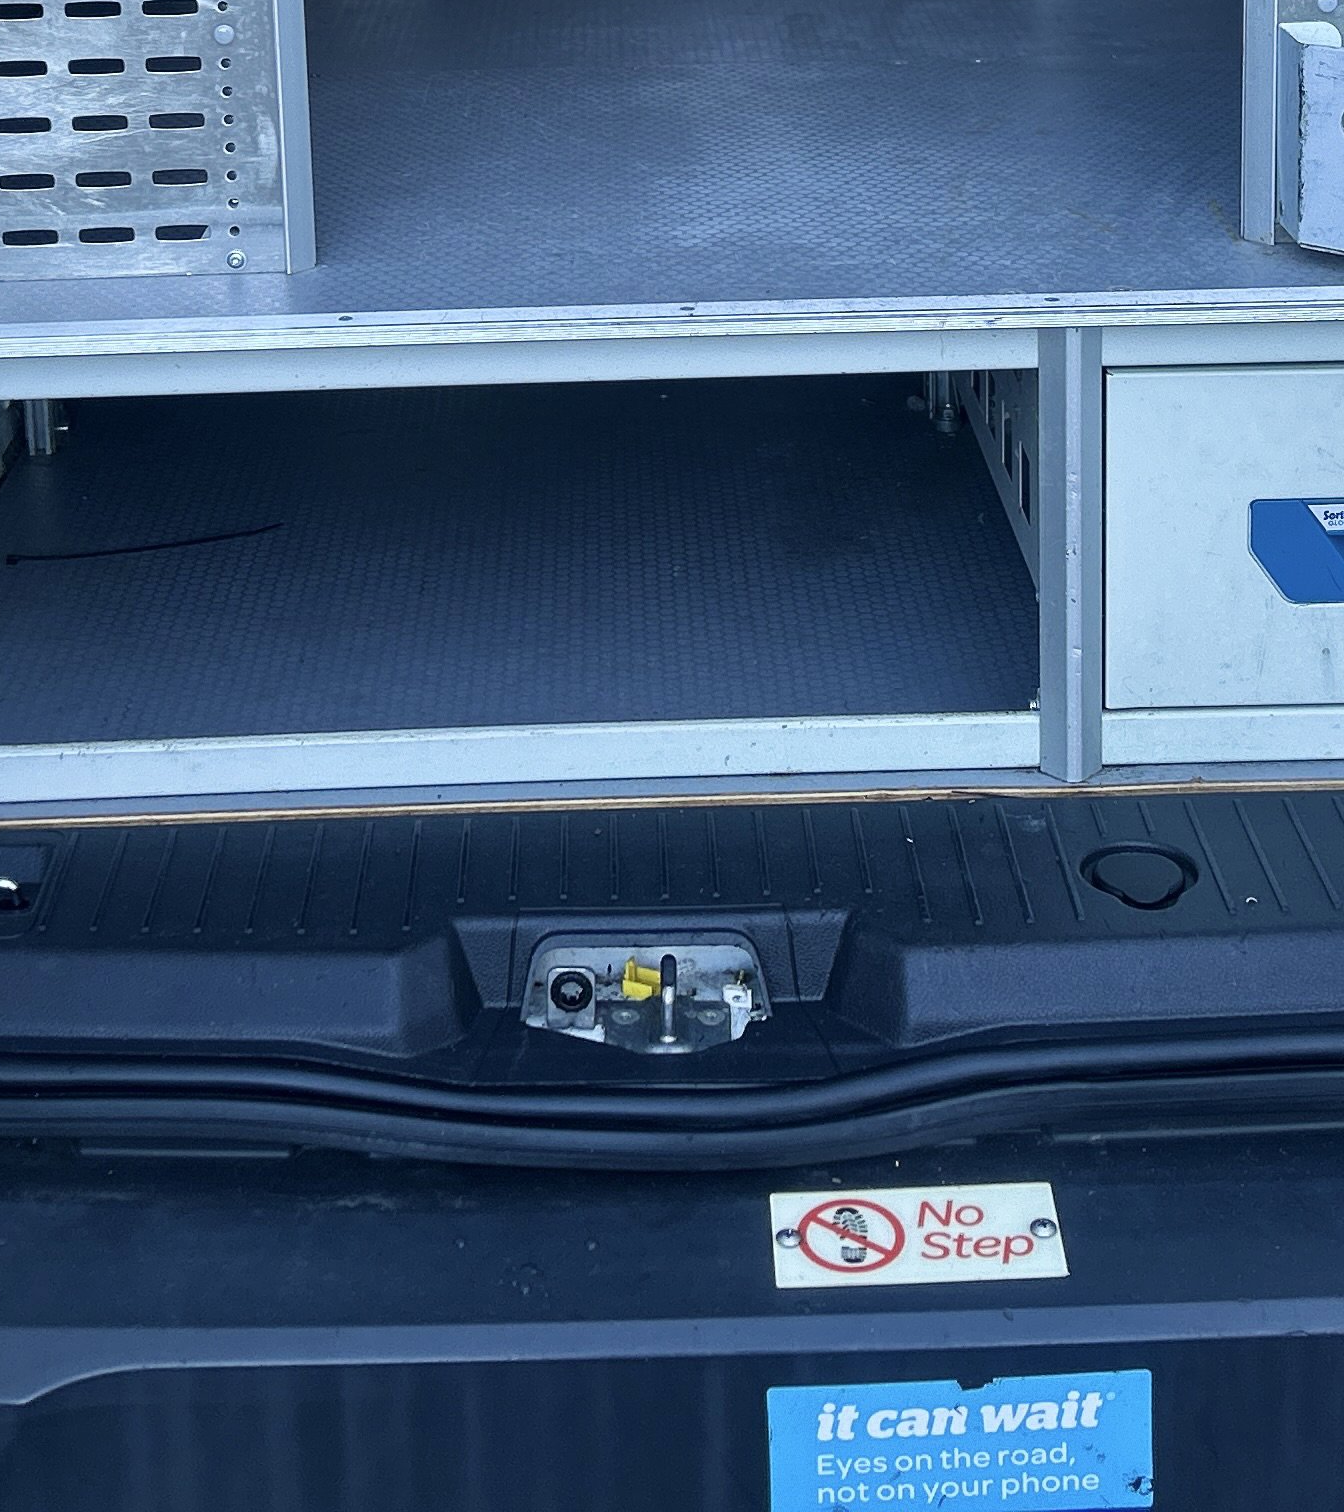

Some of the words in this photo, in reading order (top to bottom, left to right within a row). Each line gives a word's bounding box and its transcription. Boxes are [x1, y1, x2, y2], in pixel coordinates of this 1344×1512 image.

[917, 1199, 984, 1228] No
[921, 1232, 1034, 1265] Step
[817, 1402, 860, 1441] it
[866, 1405, 969, 1439] can
[980, 1390, 1104, 1432] wait
[817, 1453, 888, 1480] Eyes
[894, 1453, 933, 1473] on
[940, 1446, 991, 1470] the
[997, 1441, 1076, 1467] road,
[817, 1482, 870, 1504] not
[876, 1483, 915, 1501] on
[922, 1478, 994, 1504] your
[1001, 1471, 1100, 1500] phone
